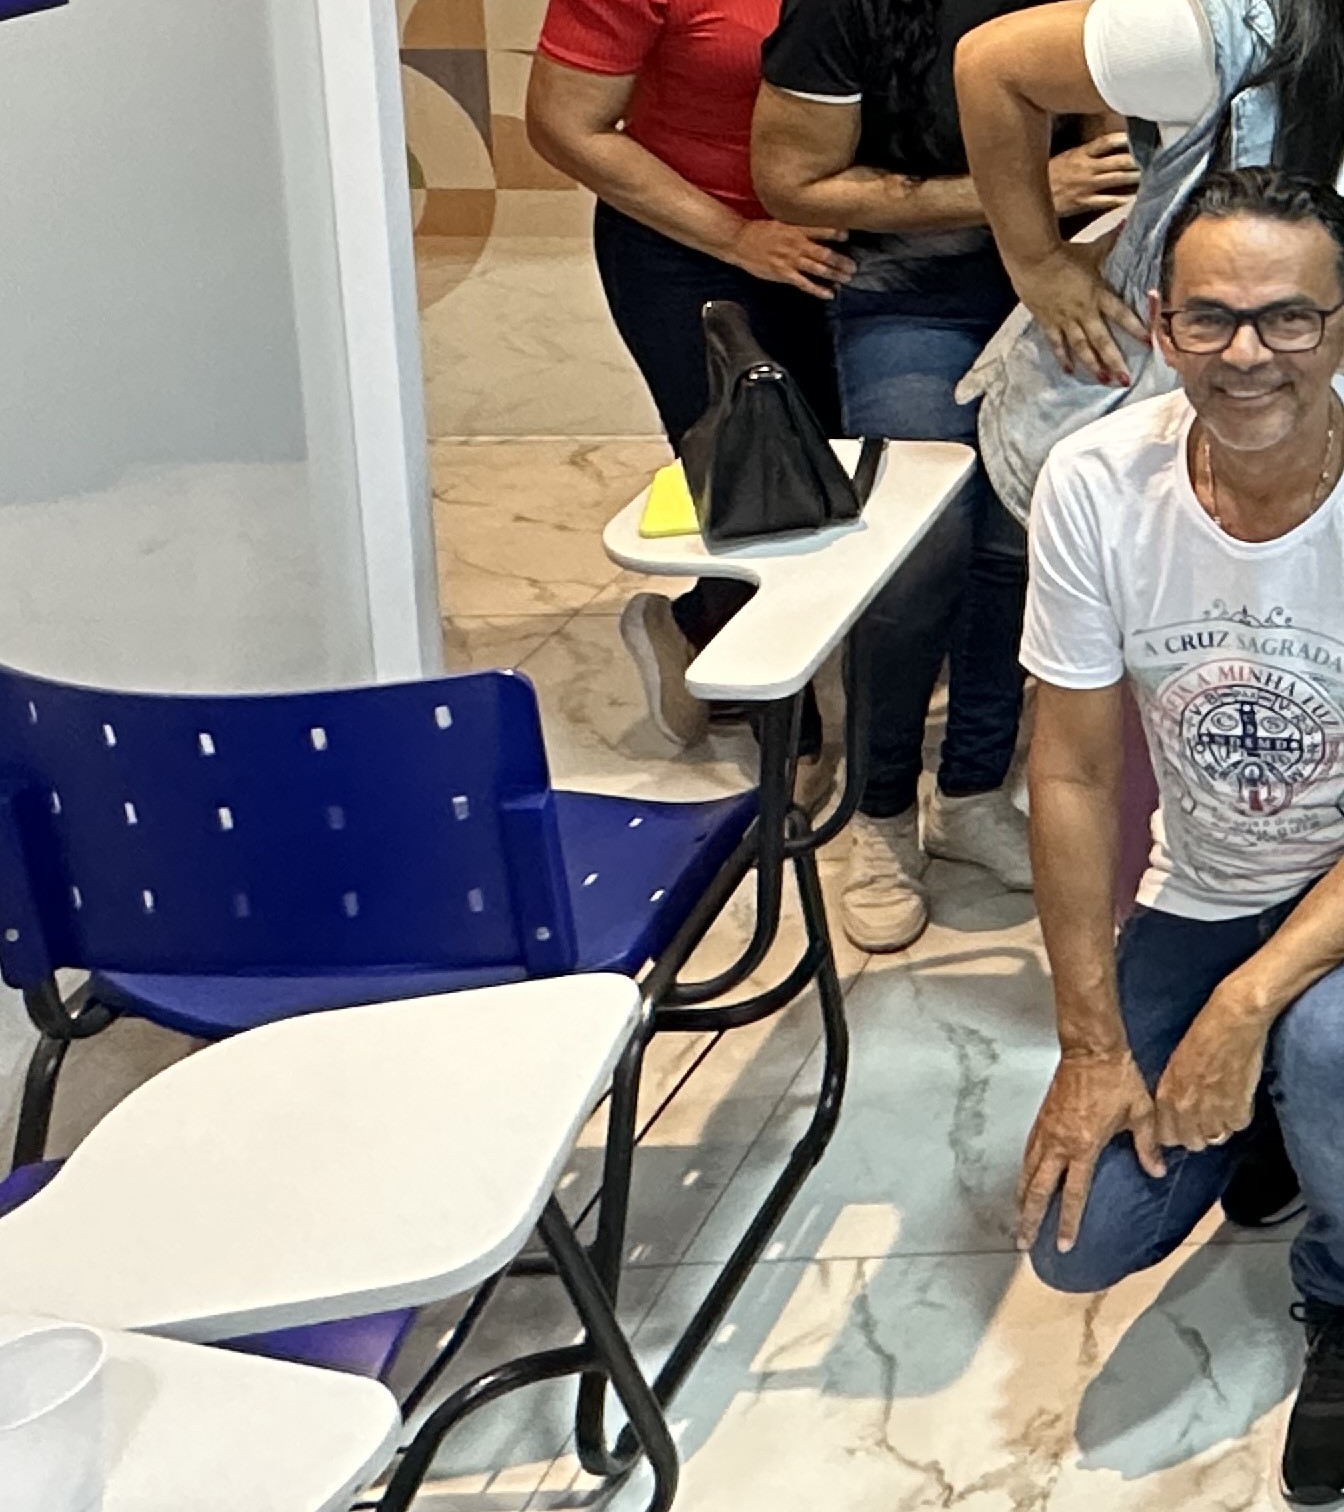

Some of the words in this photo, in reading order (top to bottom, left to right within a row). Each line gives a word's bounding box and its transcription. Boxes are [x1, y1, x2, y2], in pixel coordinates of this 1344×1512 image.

[1144, 640, 1159, 656] A
[1164, 630, 1230, 655] CRUZ
[1236, 633, 1343, 674] SAGRADA
[1218, 663, 1297, 698] MINHA
[1301, 694, 1341, 727] LUZ
